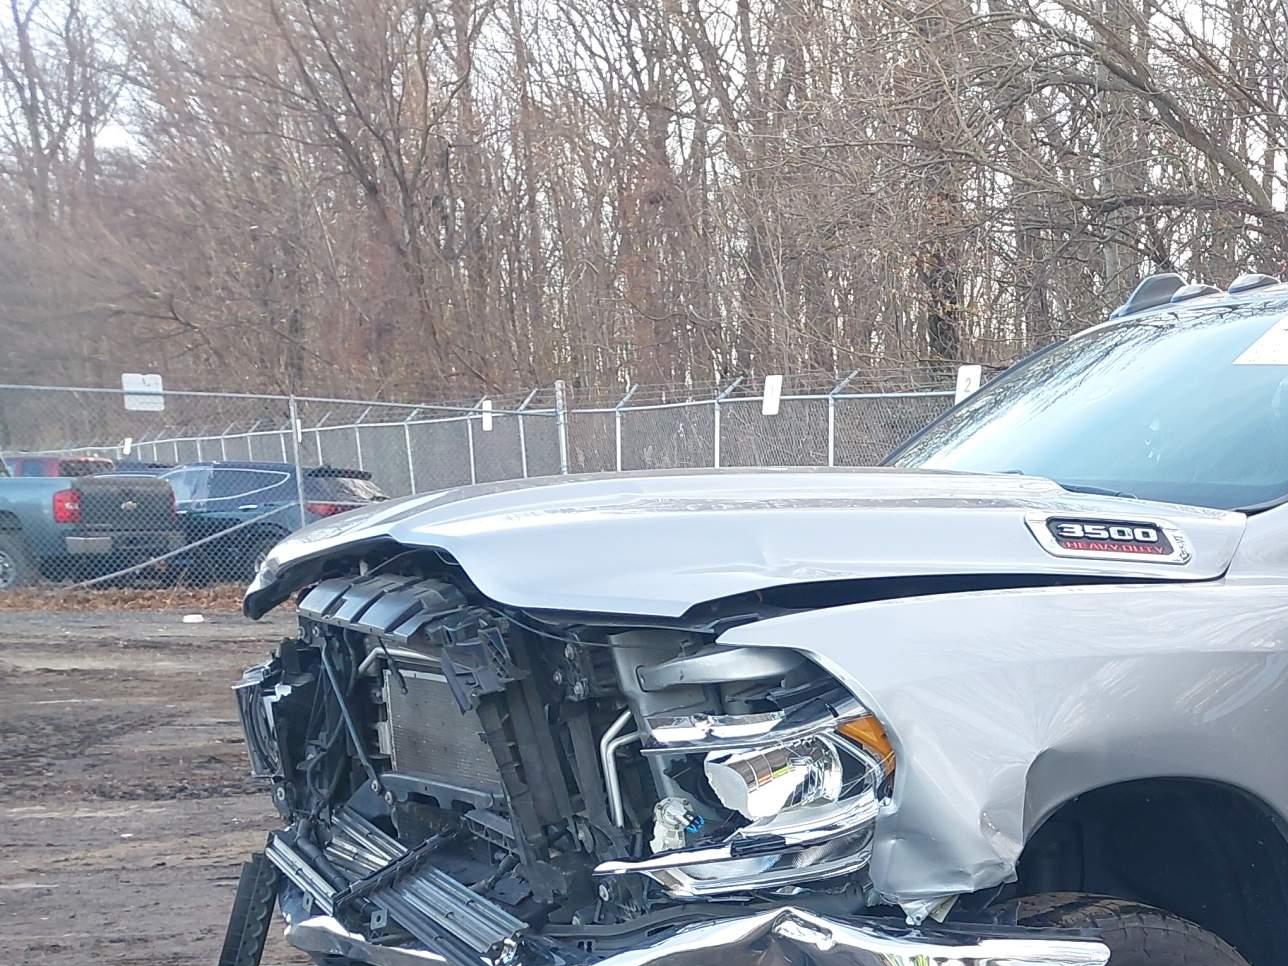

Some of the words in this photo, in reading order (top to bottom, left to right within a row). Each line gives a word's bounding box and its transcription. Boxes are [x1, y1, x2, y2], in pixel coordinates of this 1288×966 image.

[1057, 523, 1159, 543] 3500
[1062, 540, 1119, 552] HEAVY
[1121, 544, 1165, 555] DUTY
